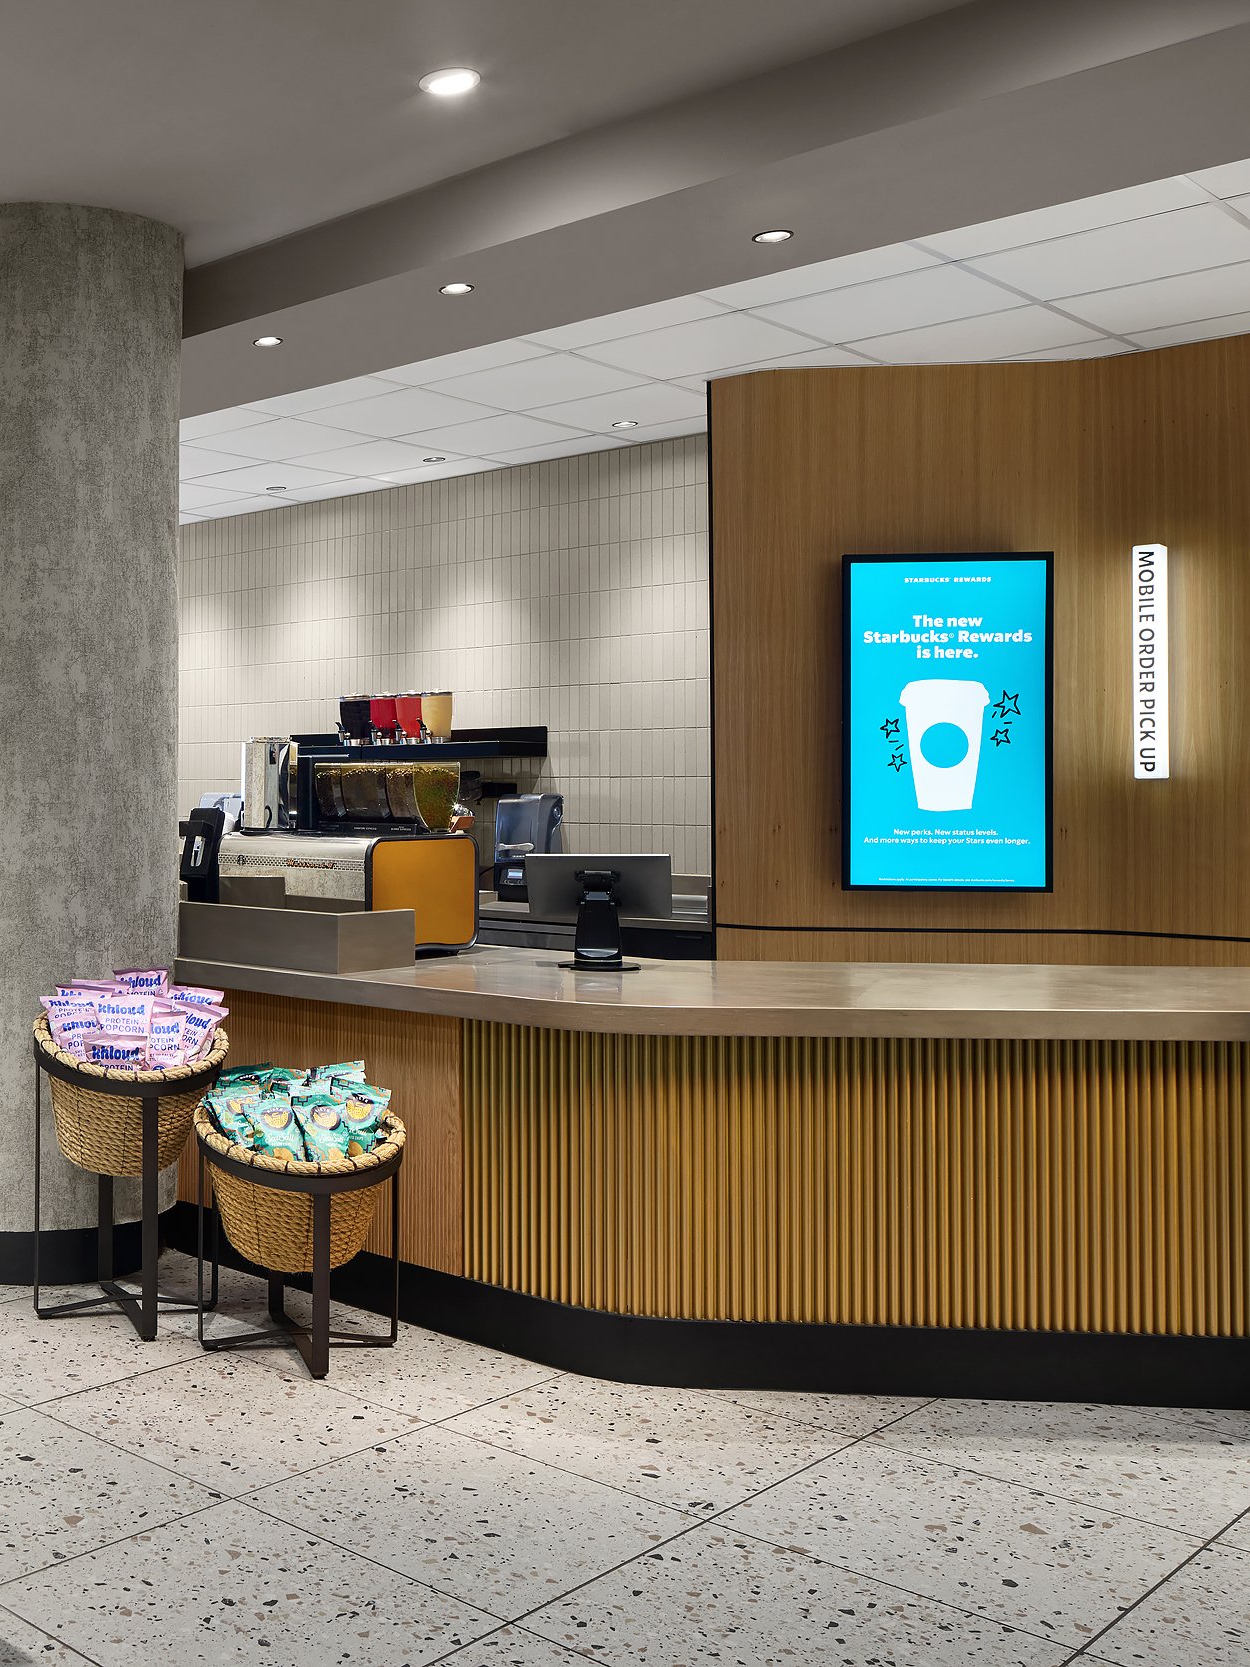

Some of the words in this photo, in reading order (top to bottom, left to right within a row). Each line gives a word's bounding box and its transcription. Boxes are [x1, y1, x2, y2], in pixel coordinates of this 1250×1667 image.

[1139, 551, 1155, 622] MOBILE
[913, 615, 944, 628] The
[947, 617, 982, 627] new
[958, 630, 1033, 642] Rewards
[916, 645, 931, 659] is
[934, 645, 979, 659] here.
[1139, 629, 1155, 693] ORDER
[1139, 699, 1156, 741] PICK
[1139, 748, 1156, 772] UP
[911, 829, 934, 837] perks.
[929, 837, 947, 845] keep
[1005, 837, 1030, 845] longer.
[98, 1003, 145, 1015] khloud
[100, 1024, 145, 1034] POPCORN
[92, 1046, 139, 1060] khloud
